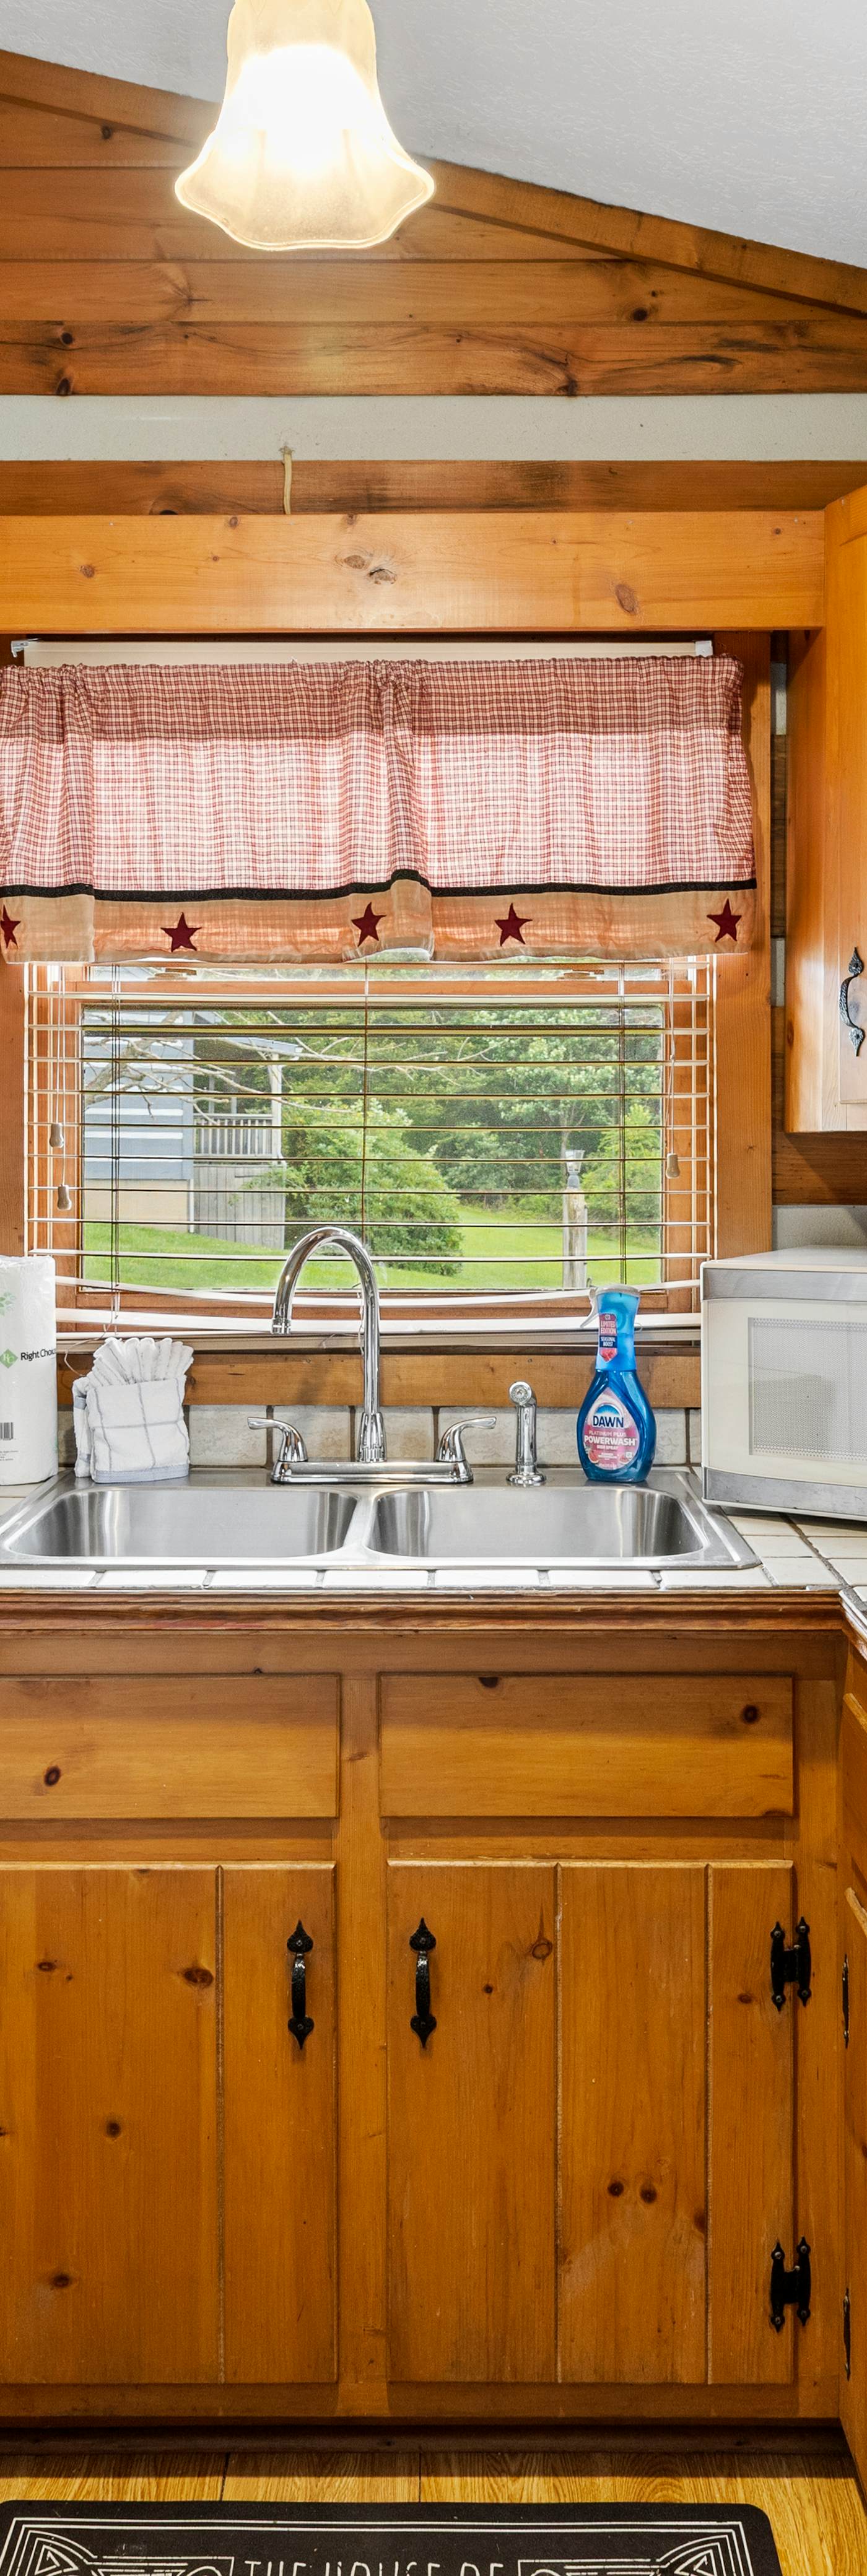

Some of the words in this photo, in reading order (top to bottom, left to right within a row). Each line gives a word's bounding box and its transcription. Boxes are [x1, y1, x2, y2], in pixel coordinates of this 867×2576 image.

[20, 1351, 40, 1362] Right
[40, 1349, 56, 1357] Choic
[593, 1416, 624, 1427] DAWN
[584, 1435, 635, 1446] POWERWASH
